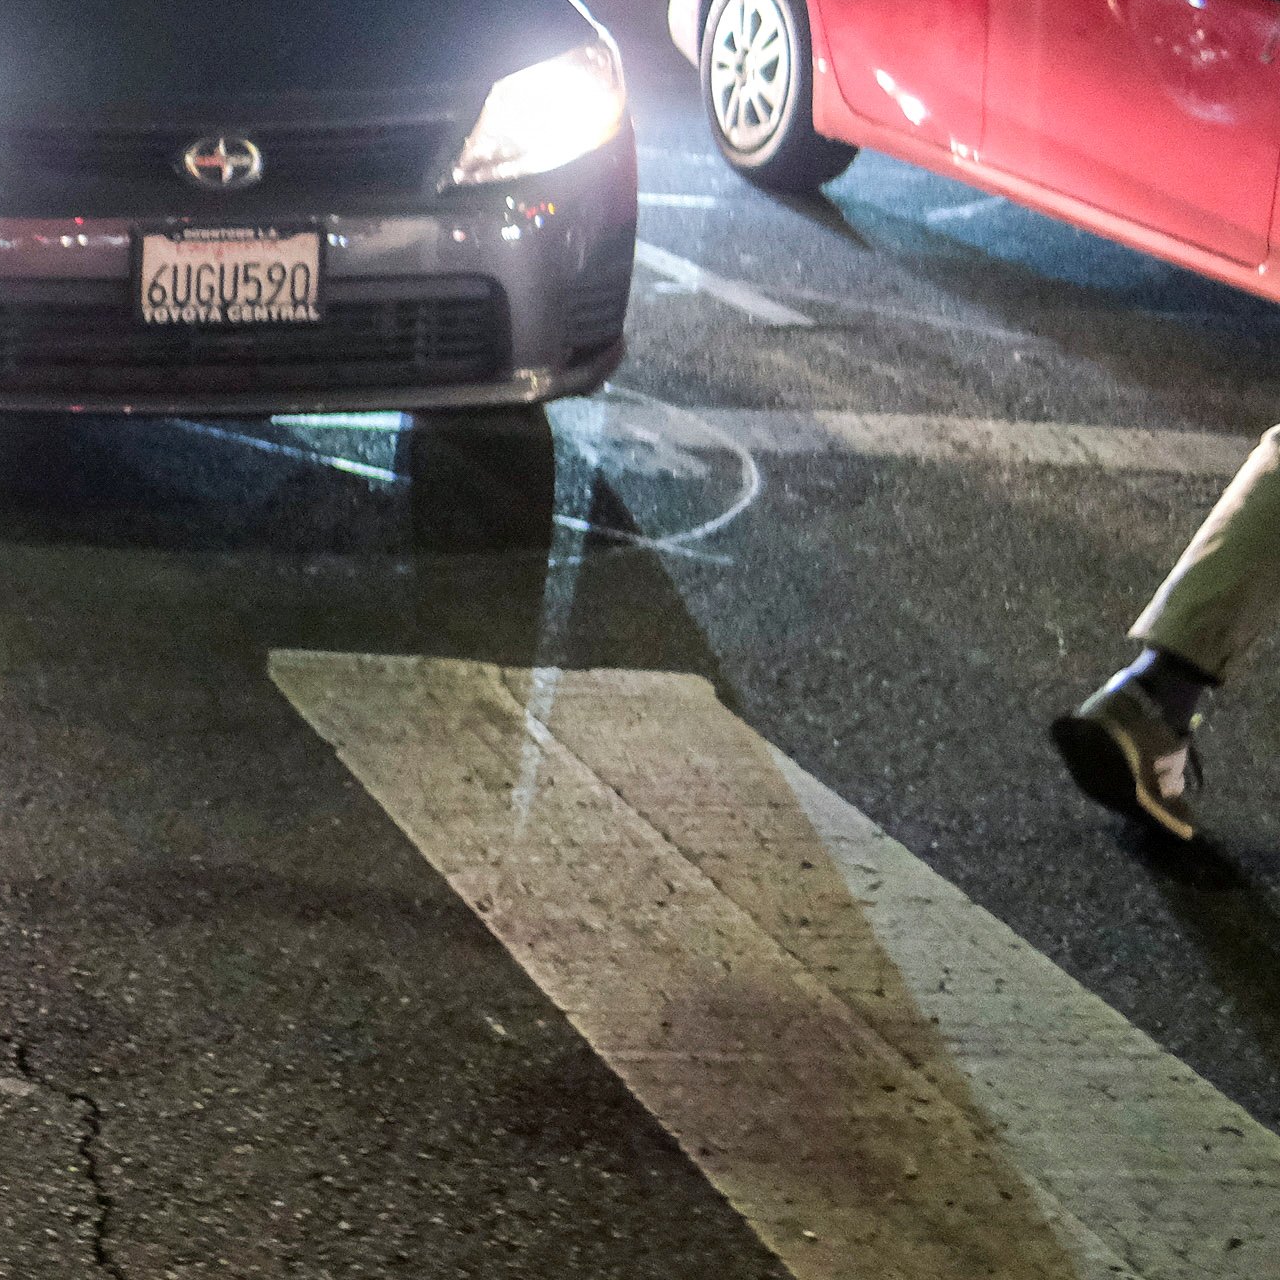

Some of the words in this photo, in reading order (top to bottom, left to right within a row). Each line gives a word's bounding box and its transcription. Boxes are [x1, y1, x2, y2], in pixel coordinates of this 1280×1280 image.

[147, 261, 311, 307] 6UGU590
[143, 303, 222, 323] TOYOTA
[227, 303, 320, 322] CENTRAL
